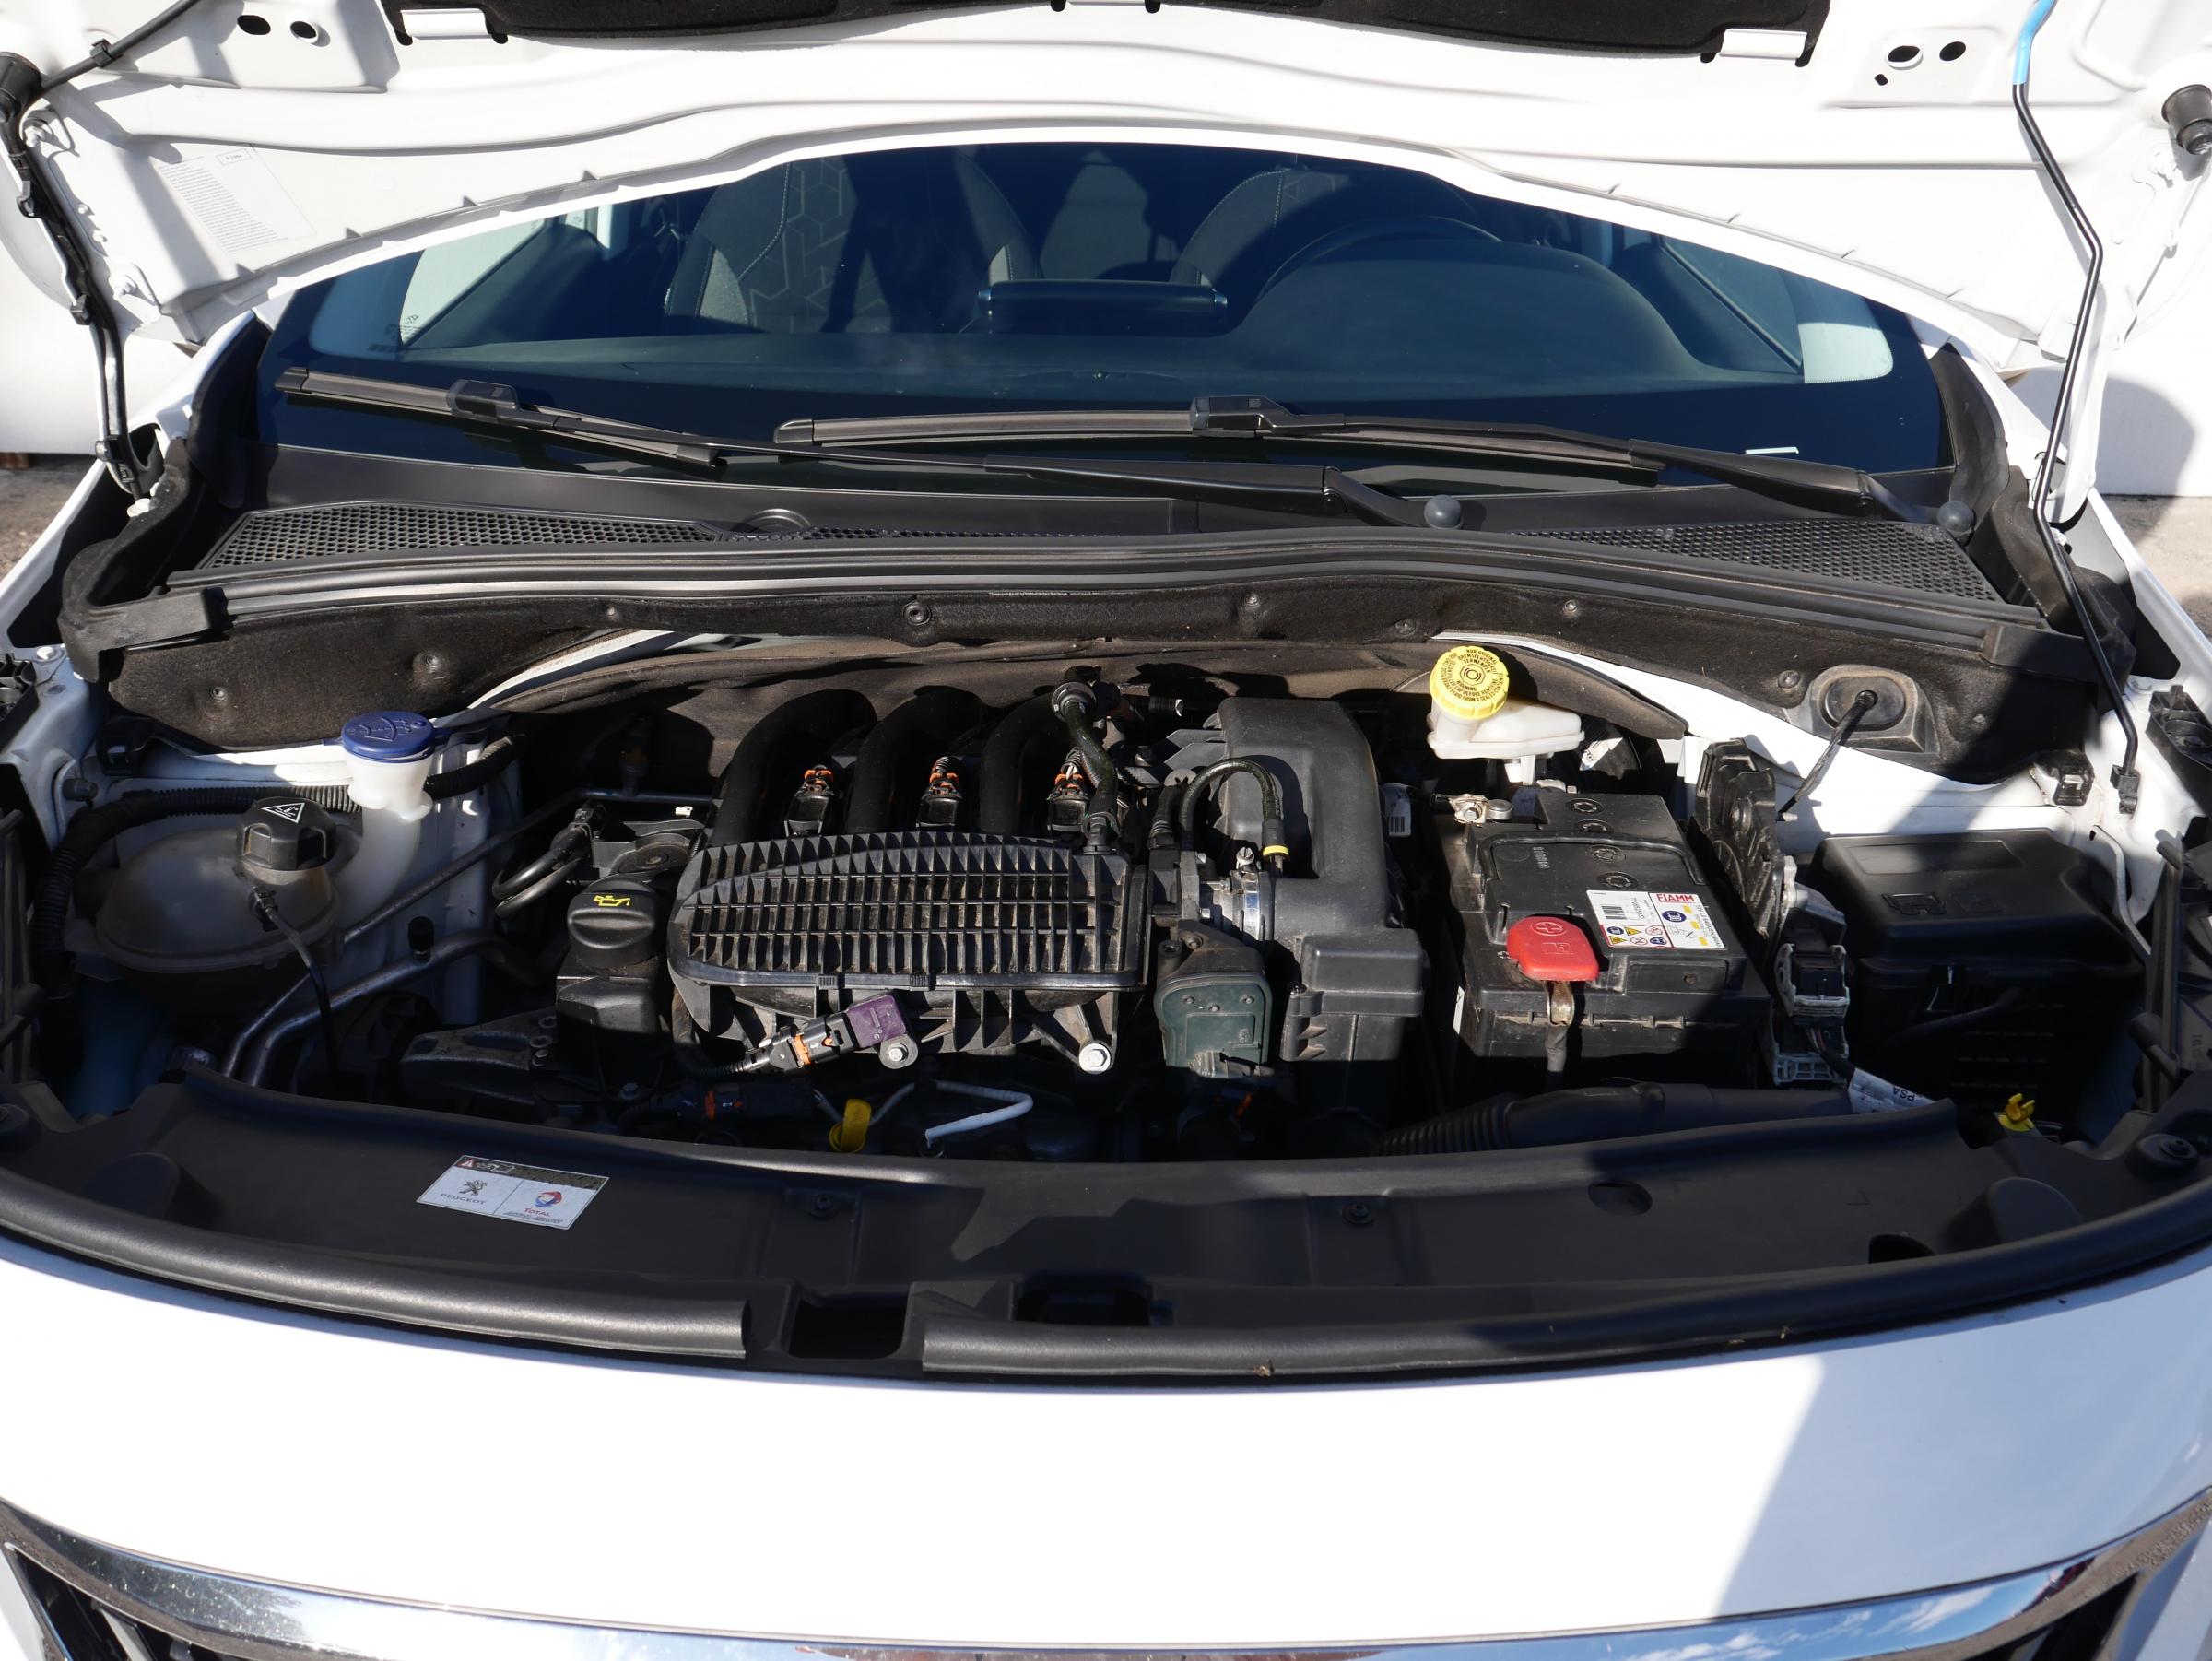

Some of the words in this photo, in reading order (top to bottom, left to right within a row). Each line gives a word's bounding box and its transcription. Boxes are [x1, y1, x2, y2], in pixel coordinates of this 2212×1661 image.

[1656, 893, 1696, 902] FIAMM
[1893, 1086, 1916, 1102] PSA
[440, 1193, 487, 1206] PEUGEOT
[524, 1207, 550, 1218] TOTAL
